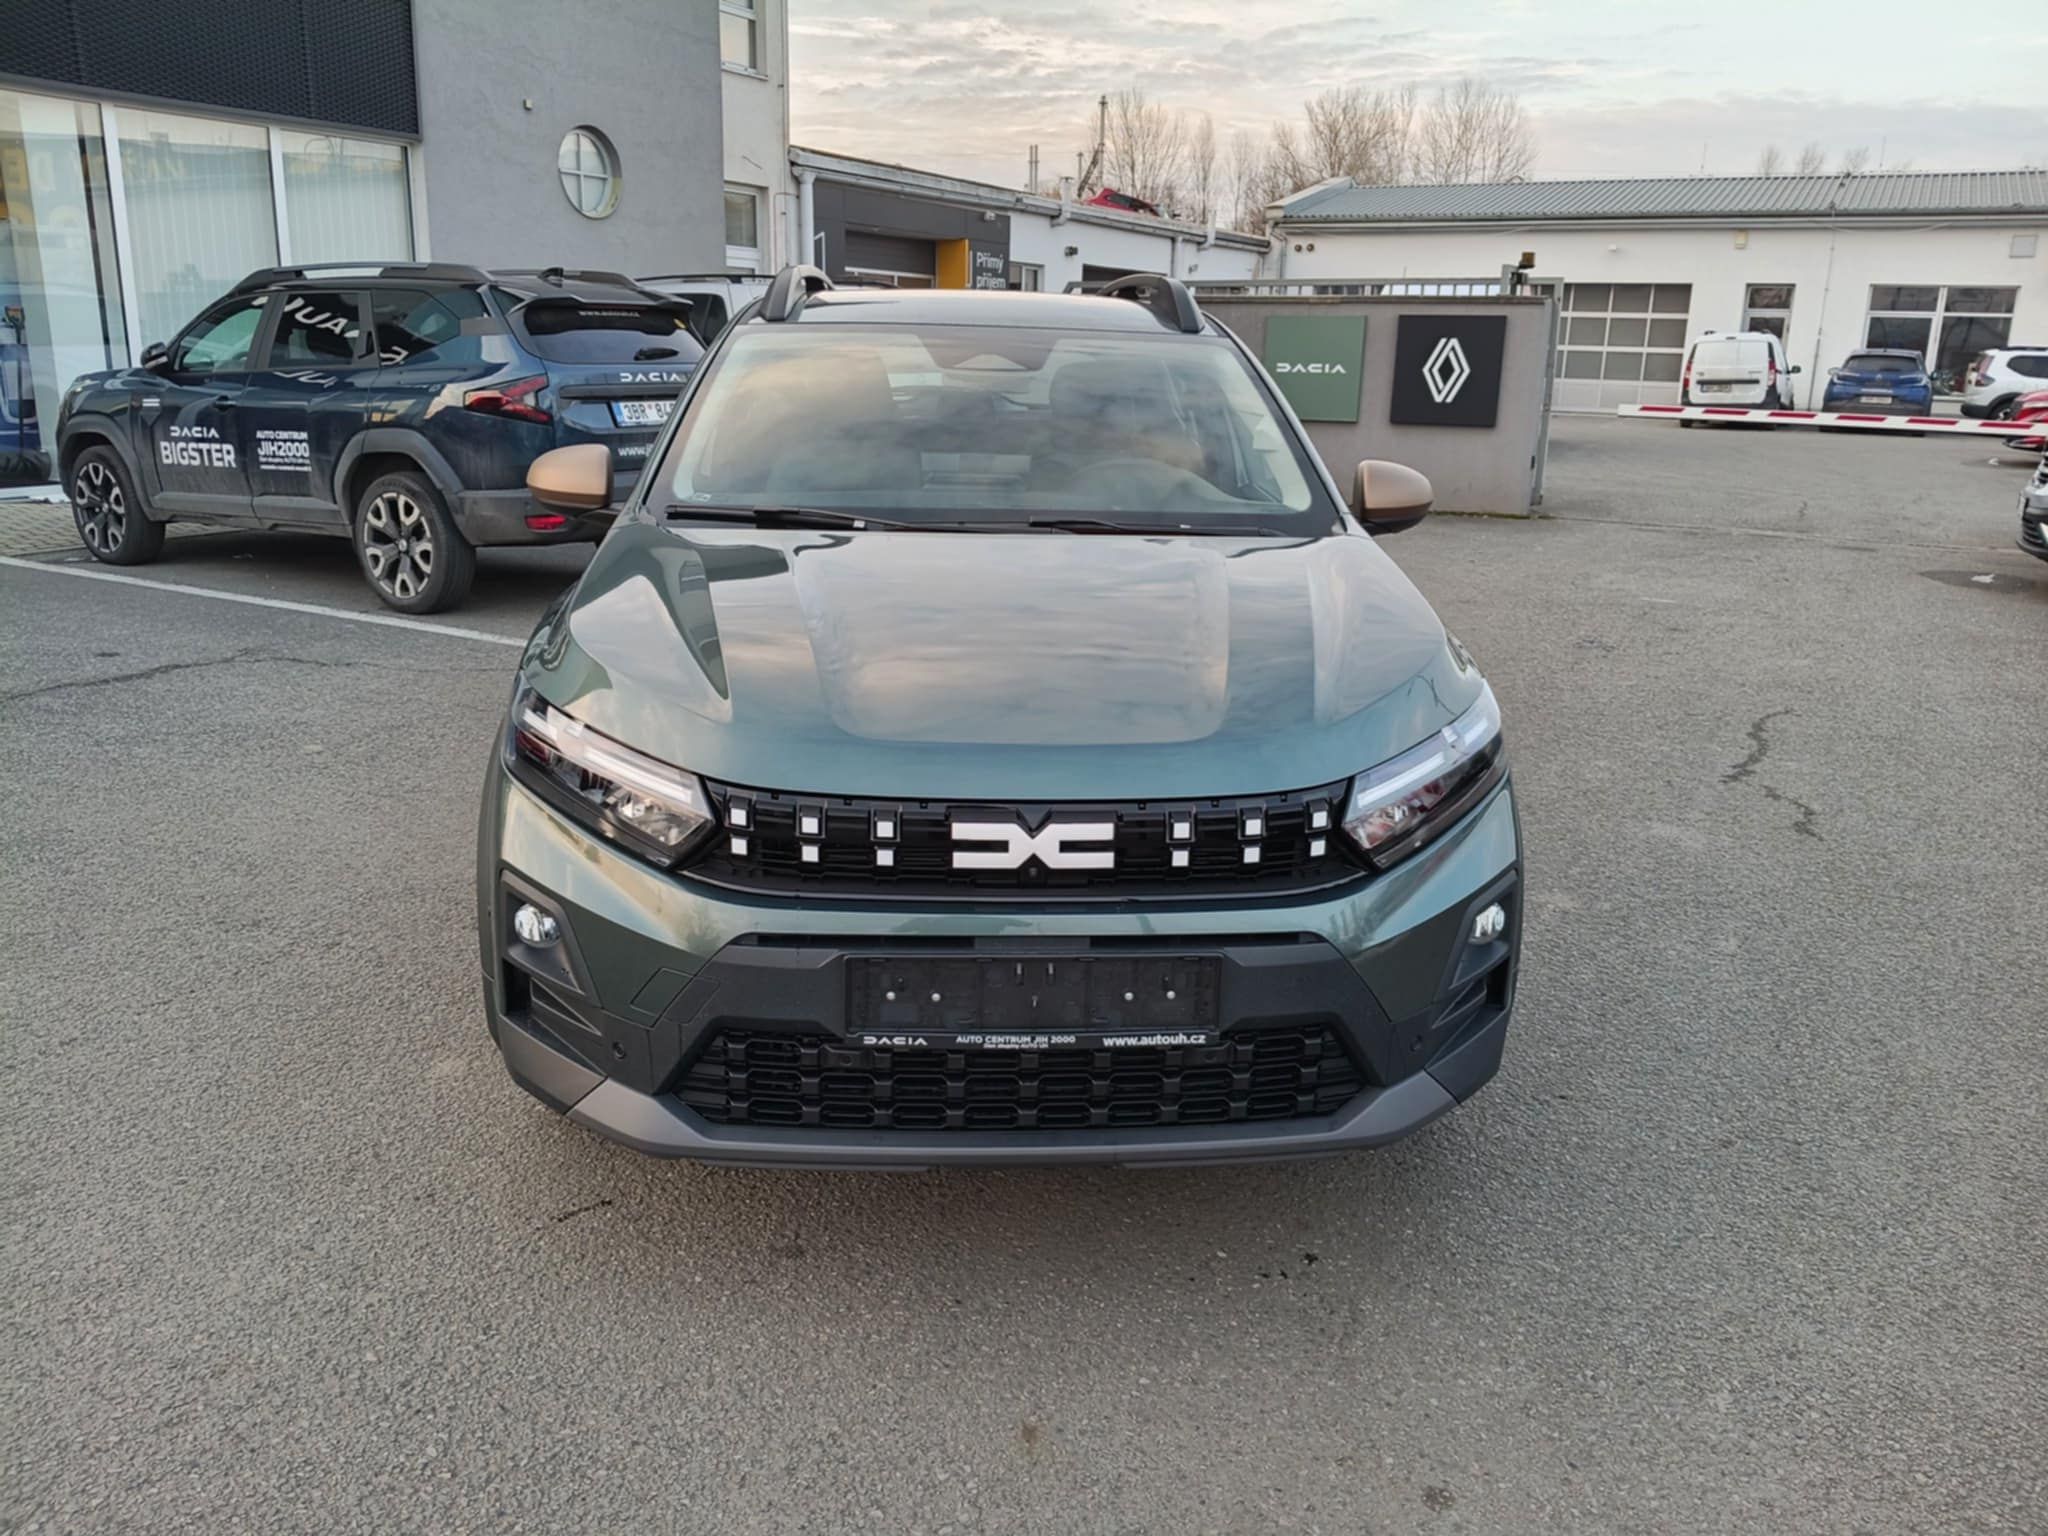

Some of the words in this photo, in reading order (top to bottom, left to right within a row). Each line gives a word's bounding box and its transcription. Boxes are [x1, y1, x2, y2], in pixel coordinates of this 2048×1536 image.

[1276, 362, 1347, 374] DACIA
[619, 372, 681, 383] DACIA
[622, 403, 650, 421] 3BR
[169, 425, 220, 439] DACIA
[159, 440, 237, 468] BIGSTER
[257, 440, 310, 458] JIH2000
[863, 1035, 928, 1046] DACIA
[955, 1034, 983, 1044] AUTO
[985, 1034, 1031, 1044] CENTRUM
[1050, 1034, 1076, 1044] 2000
[1102, 1032, 1206, 1047] www.autouh.cz
